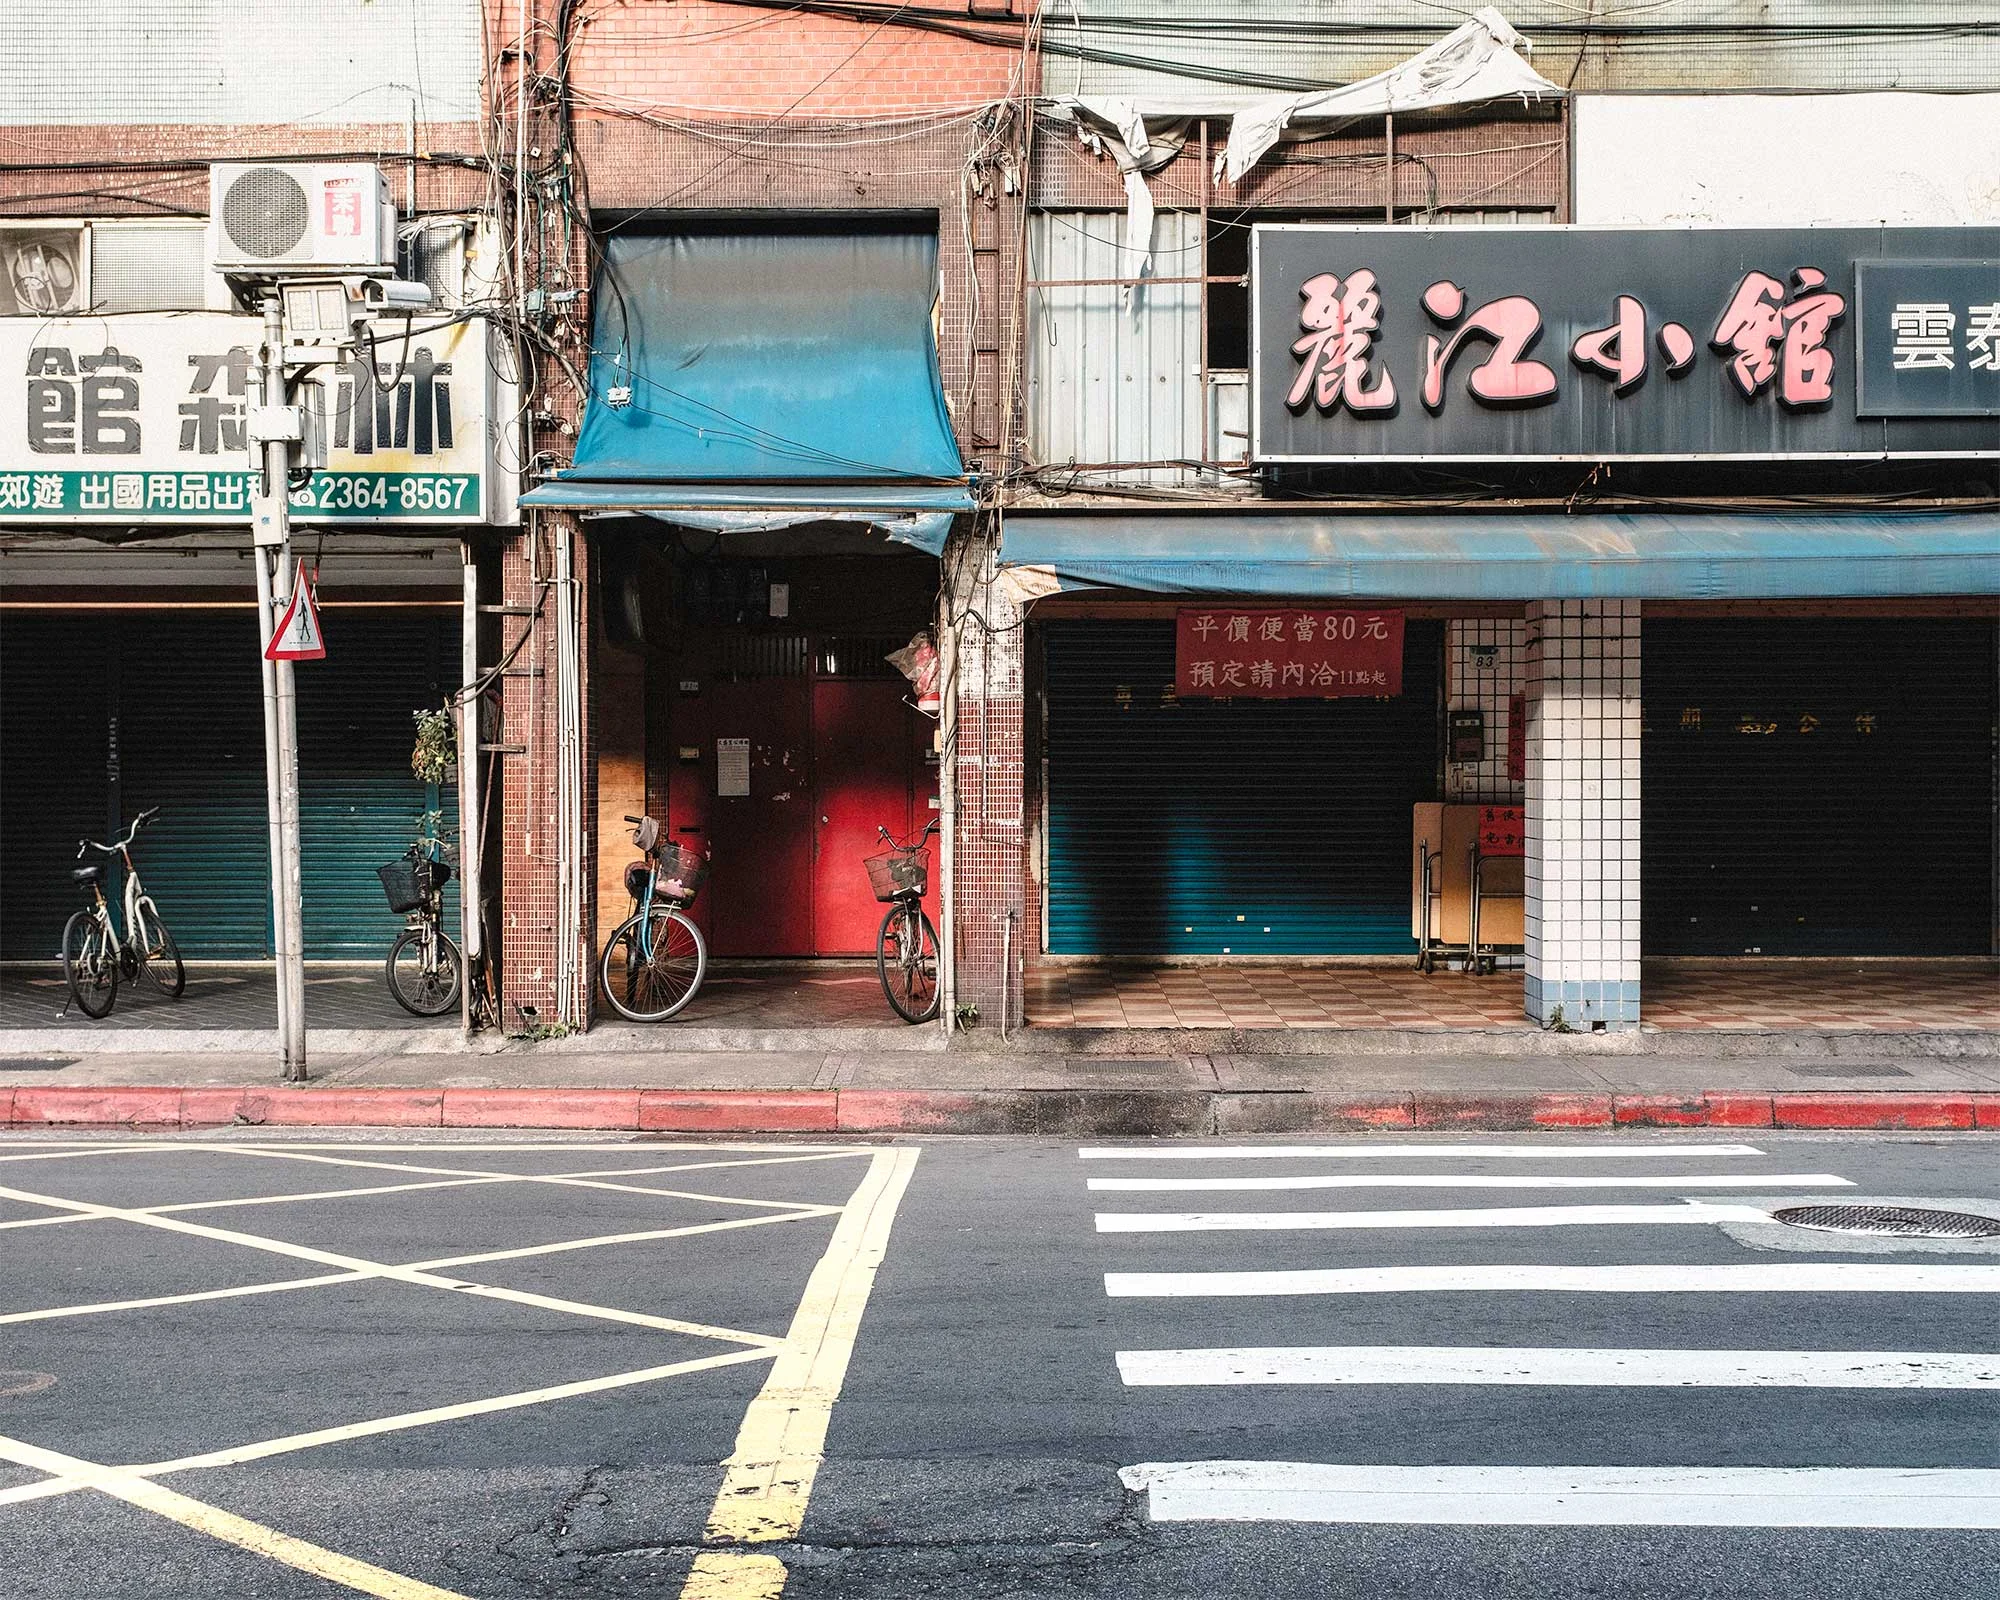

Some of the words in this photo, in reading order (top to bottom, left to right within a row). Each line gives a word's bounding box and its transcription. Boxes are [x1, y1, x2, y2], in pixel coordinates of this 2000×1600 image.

[1285, 267, 1847, 411] 麗江小館
[319, 477, 469, 510] 2364-8567
[1192, 614, 1389, 643] 平價便當80元
[1476, 656, 1494, 667] 83
